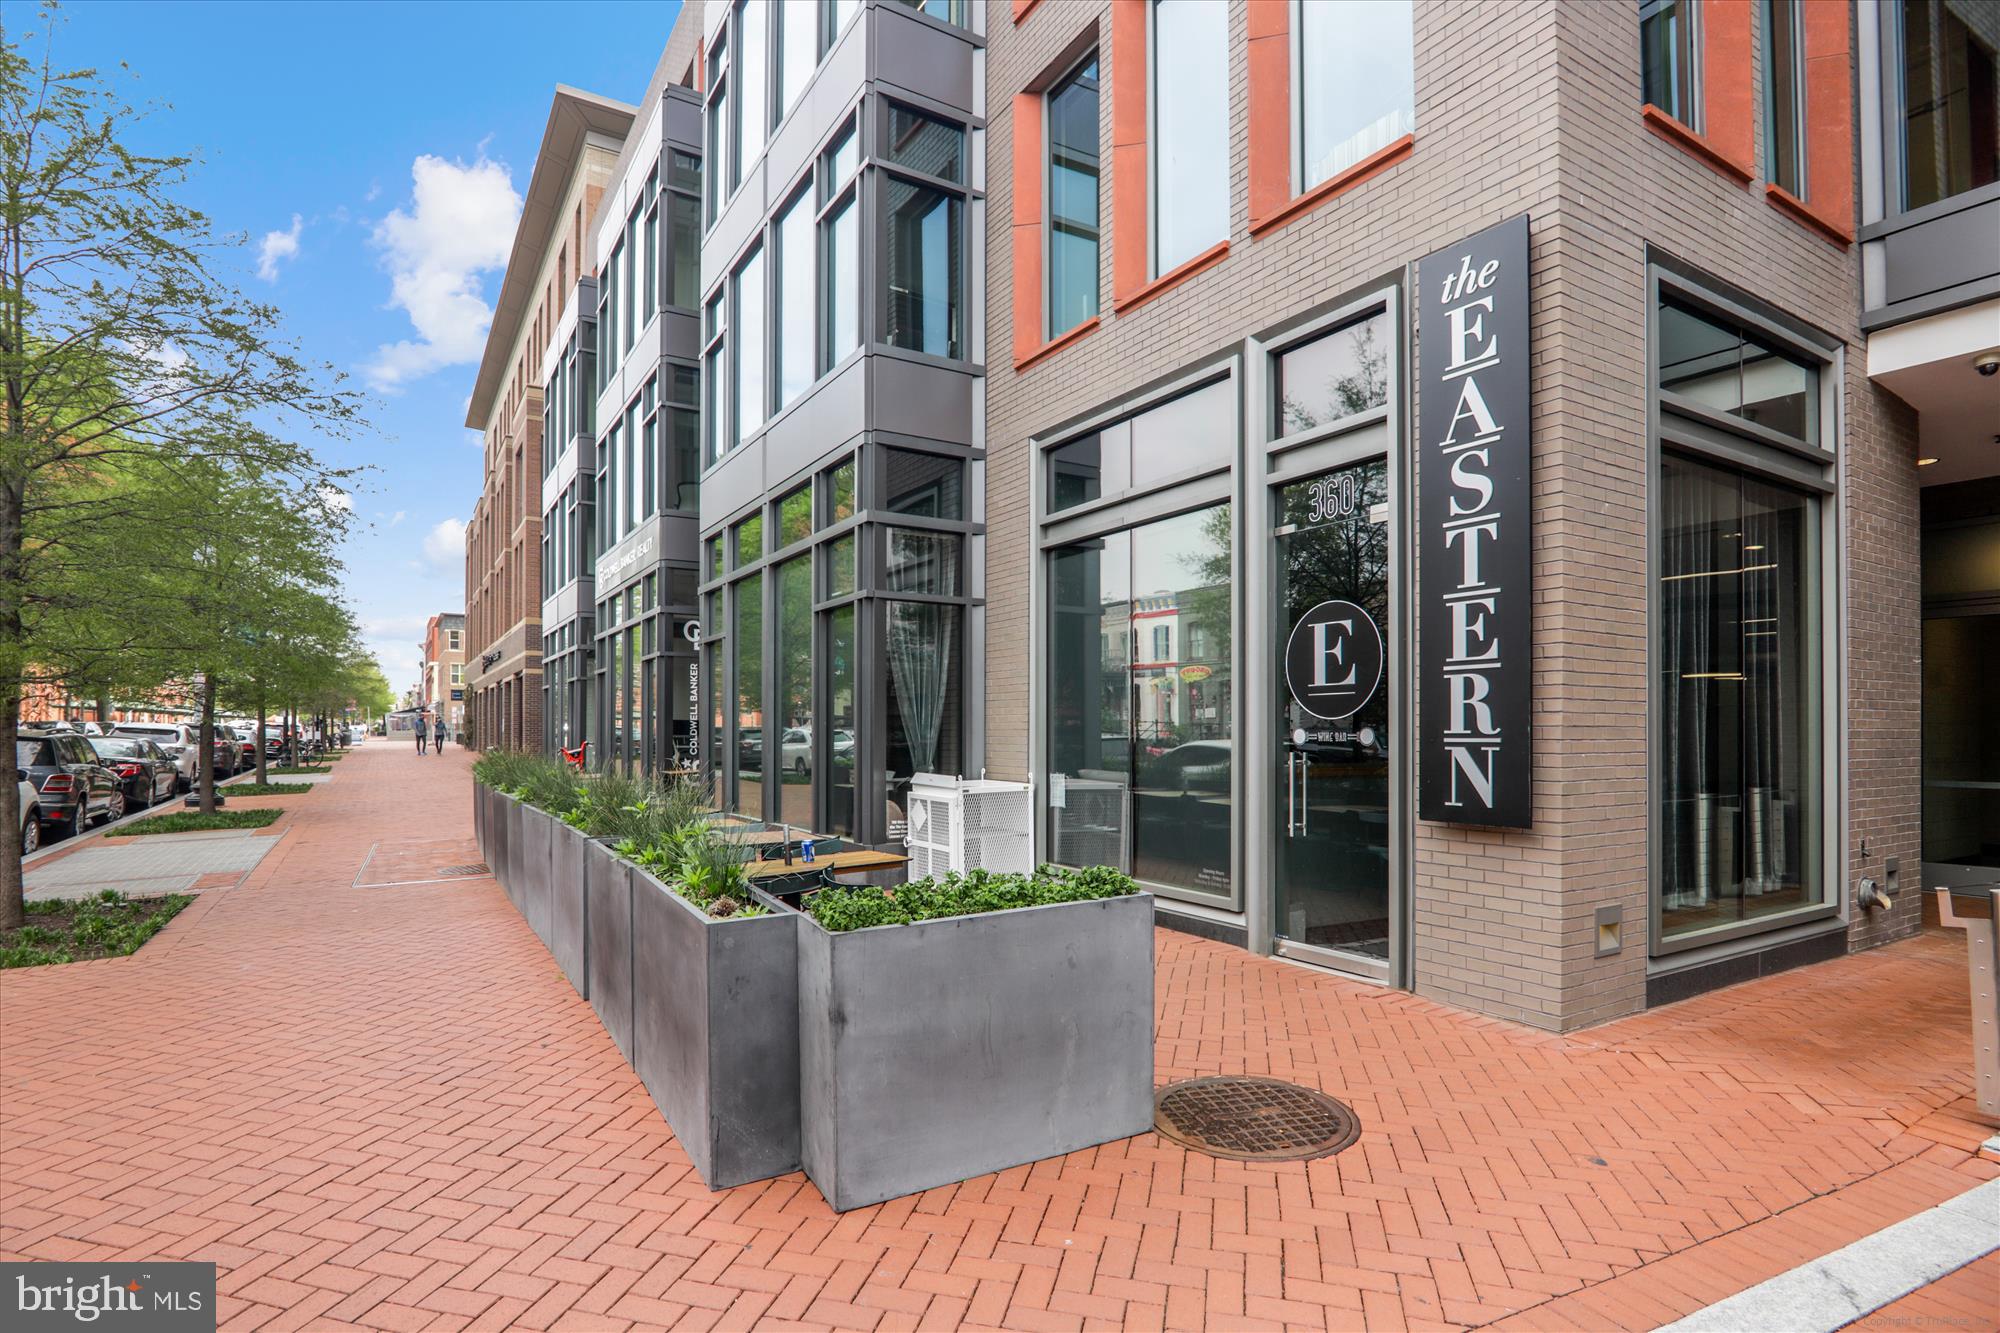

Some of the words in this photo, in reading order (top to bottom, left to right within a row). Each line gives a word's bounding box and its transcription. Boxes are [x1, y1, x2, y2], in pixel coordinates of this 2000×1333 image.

[1441, 254, 1500, 304] the
[1308, 474, 1354, 522] 360
[1439, 295, 1504, 809] EASTERN
[1307, 618, 1356, 687] E
[689, 663, 698, 702] BANKER
[689, 703, 698, 755] COLDWELL
